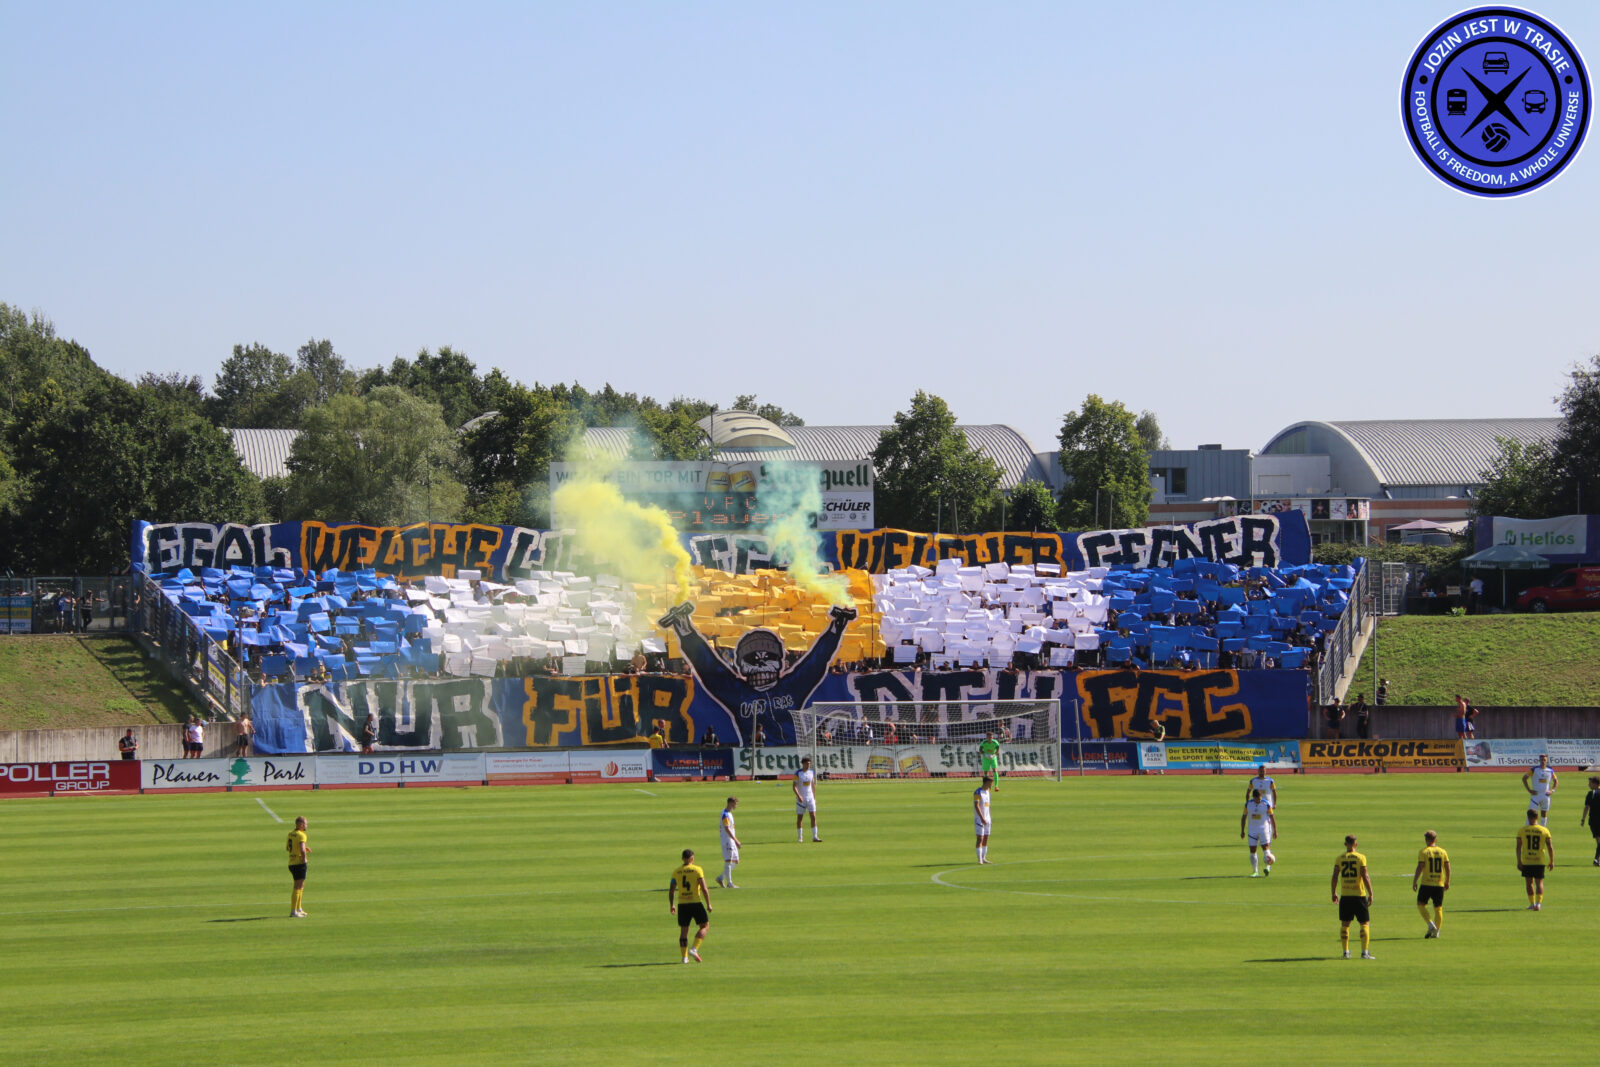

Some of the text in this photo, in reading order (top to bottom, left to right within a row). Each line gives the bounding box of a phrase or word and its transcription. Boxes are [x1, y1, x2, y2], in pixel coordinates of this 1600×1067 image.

[617, 471, 640, 483] EIN
[647, 470, 673, 482] TOR
[678, 470, 702, 483] MIT
[1520, 530, 1575, 545] Helios
[142, 521, 291, 578] EGAL
[1077, 514, 1280, 570] GEGNER
[297, 678, 503, 753] NUR
[523, 675, 695, 748] FÜR
[1208, 747, 1229, 755] PARK
[1308, 741, 1429, 757] Rückoldt
[358, 759, 439, 776] DDHW
[1331, 758, 1383, 767] PEUGEOT
[1413, 758, 1465, 767] PEUGEOT
[1549, 757, 1596, 765] Fotostudio
[152, 763, 221, 783] Plauen
[263, 761, 306, 782] Park
[55, 780, 110, 790] GROUP
[1526, 835, 1541, 850] 18
[1341, 861, 1358, 878] 25
[1428, 857, 1443, 874] 10
[682, 875, 691, 891] 4
